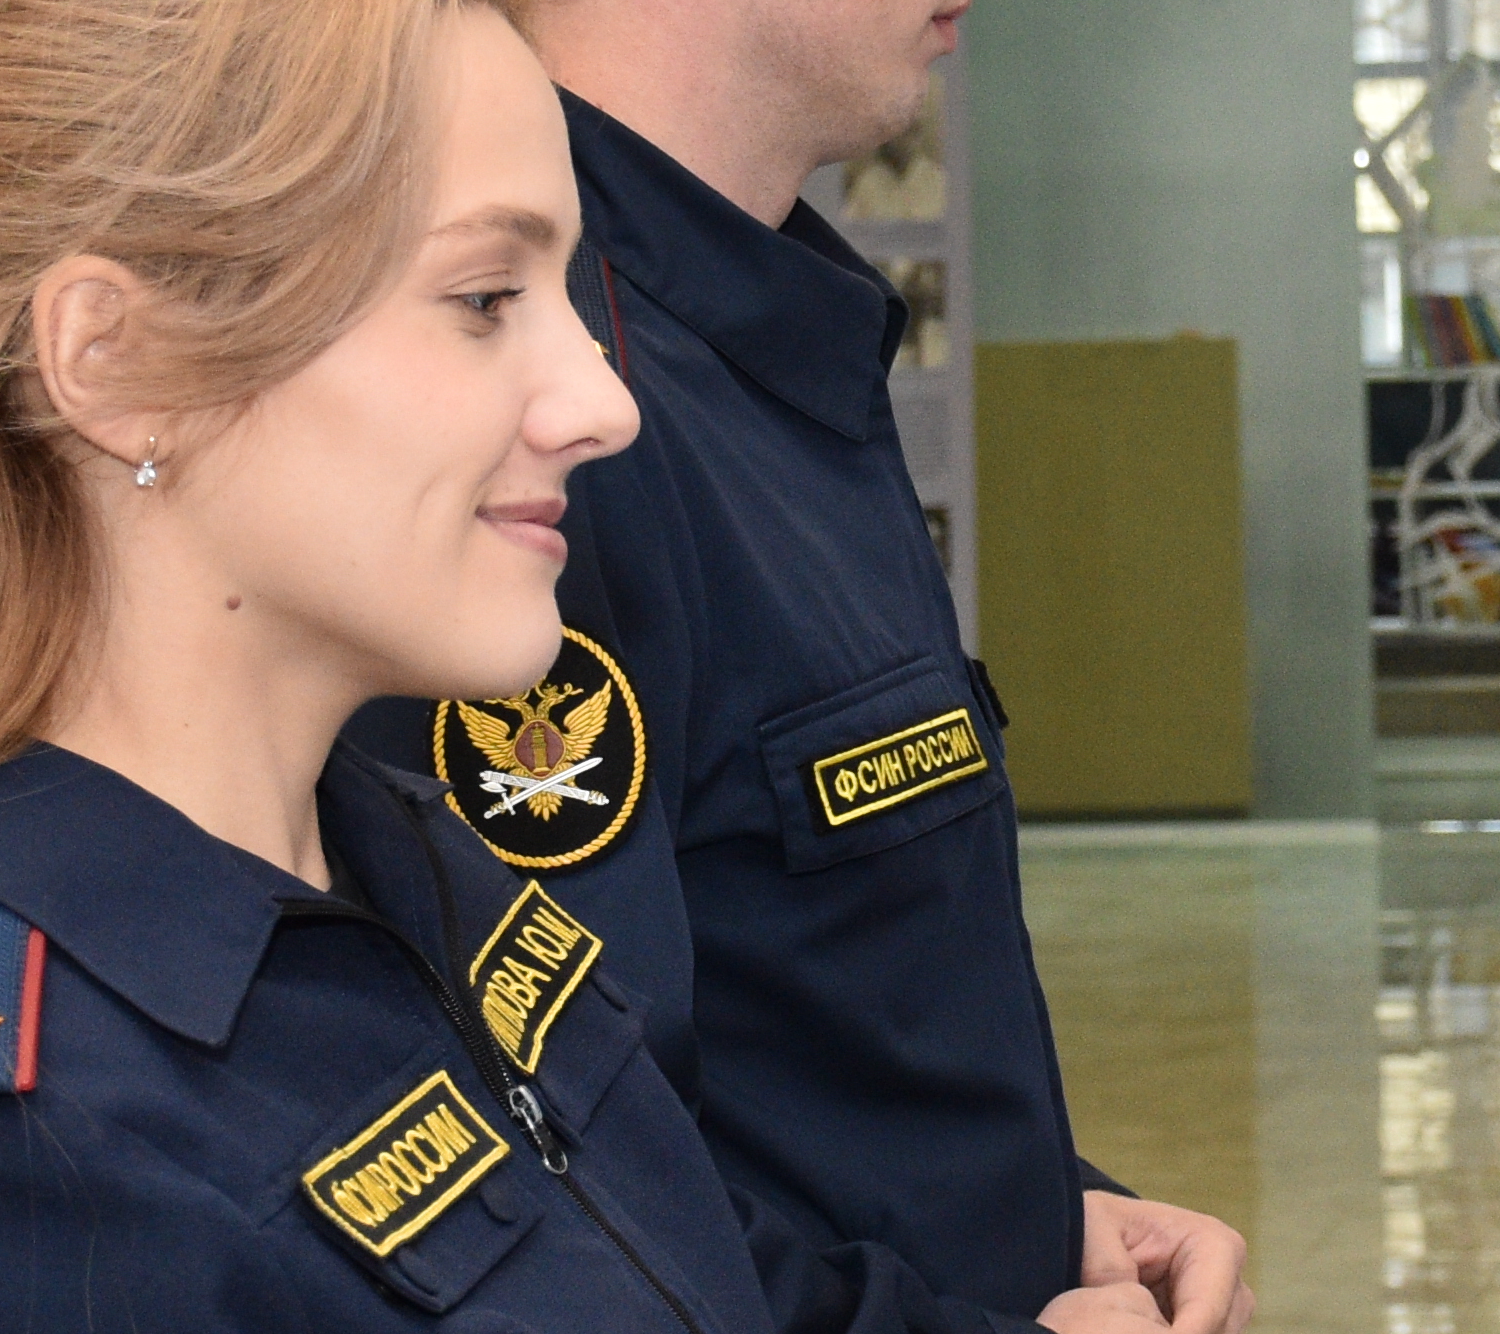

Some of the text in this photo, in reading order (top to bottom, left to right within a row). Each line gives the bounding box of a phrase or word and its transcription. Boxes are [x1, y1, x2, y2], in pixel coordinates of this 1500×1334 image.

[834, 724, 974, 802] ФСИН РОССИИ
[515, 906, 583, 971] Ю.М.
[366, 1103, 477, 1205] РОССИИ
